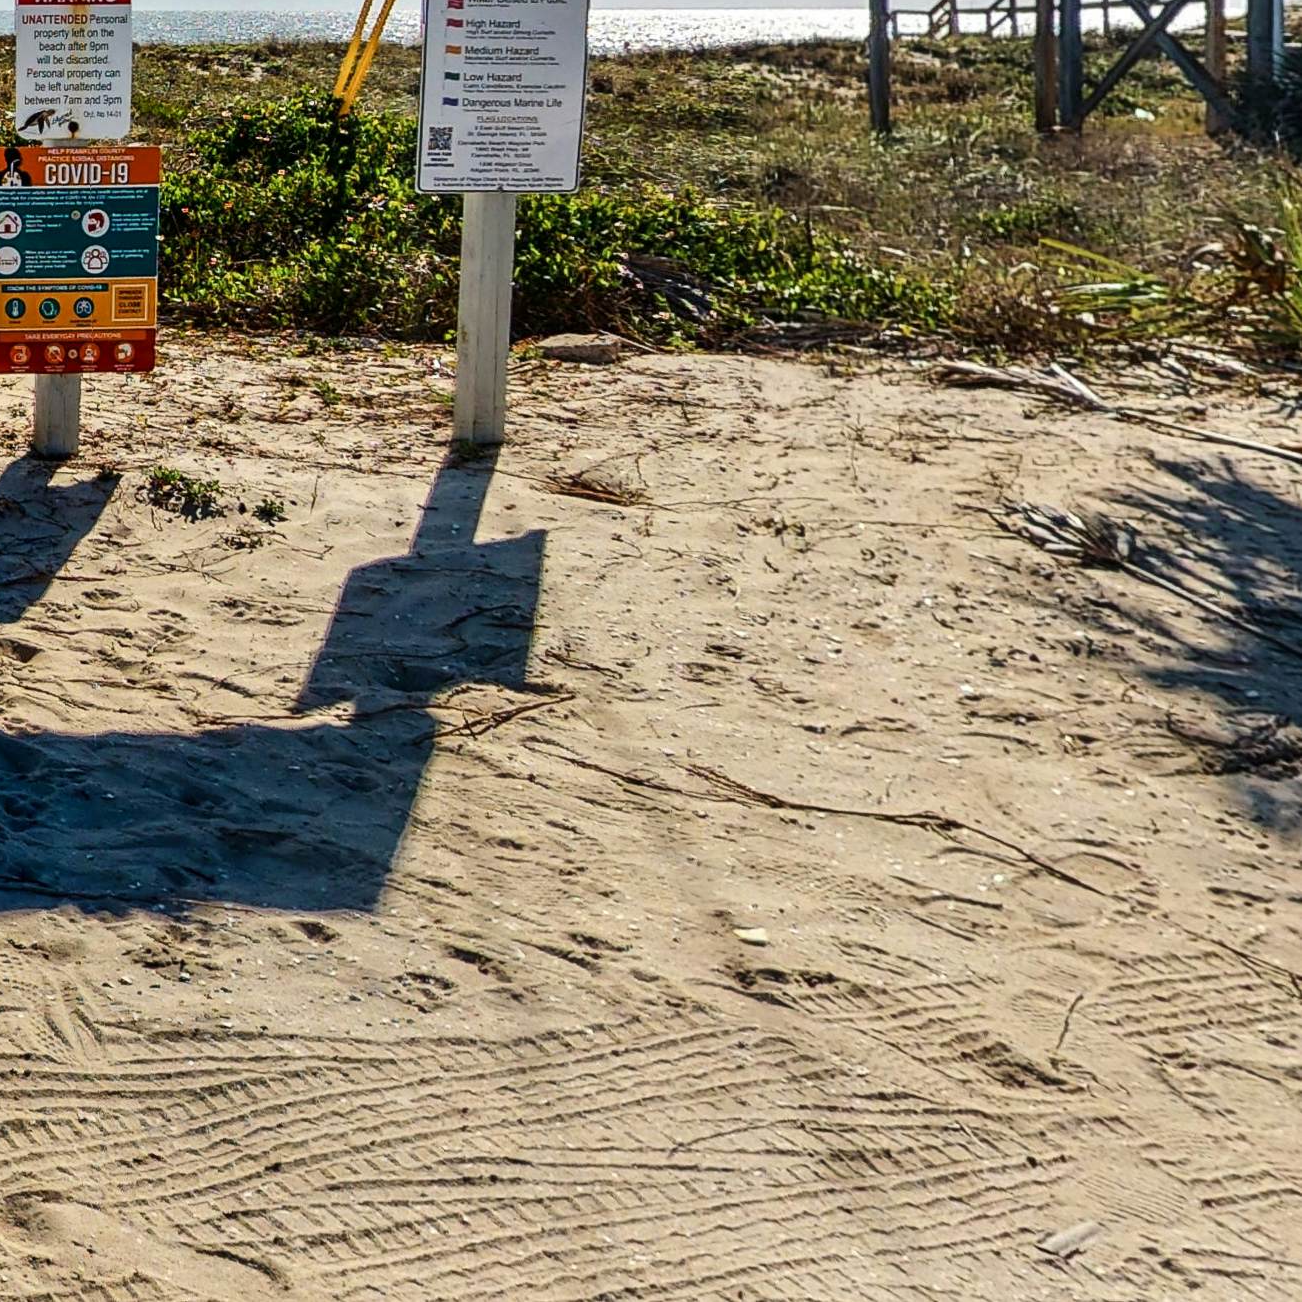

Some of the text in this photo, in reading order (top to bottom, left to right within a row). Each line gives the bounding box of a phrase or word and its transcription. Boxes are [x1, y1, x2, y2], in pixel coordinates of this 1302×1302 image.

[22, 14, 128, 25] UNATTENDED Personal
[466, 19, 520, 29] High Hazard
[33, 28, 115, 39] property left on the
[39, 41, 109, 52] beach after 9pm
[464, 46, 539, 55] Medium Hazard
[37, 55, 51, 64] will
[52, 55, 63, 64] be
[27, 68, 121, 79] Personal property can
[463, 73, 522, 82] Low Hazard
[34, 82, 112, 91] be left unattended
[24, 95, 61, 105] between
[63, 95, 82, 105] 7am
[84, 96, 101, 105] and
[462, 98, 562, 108] Dangerous Marine Life
[45, 162, 129, 185] COVID-19
